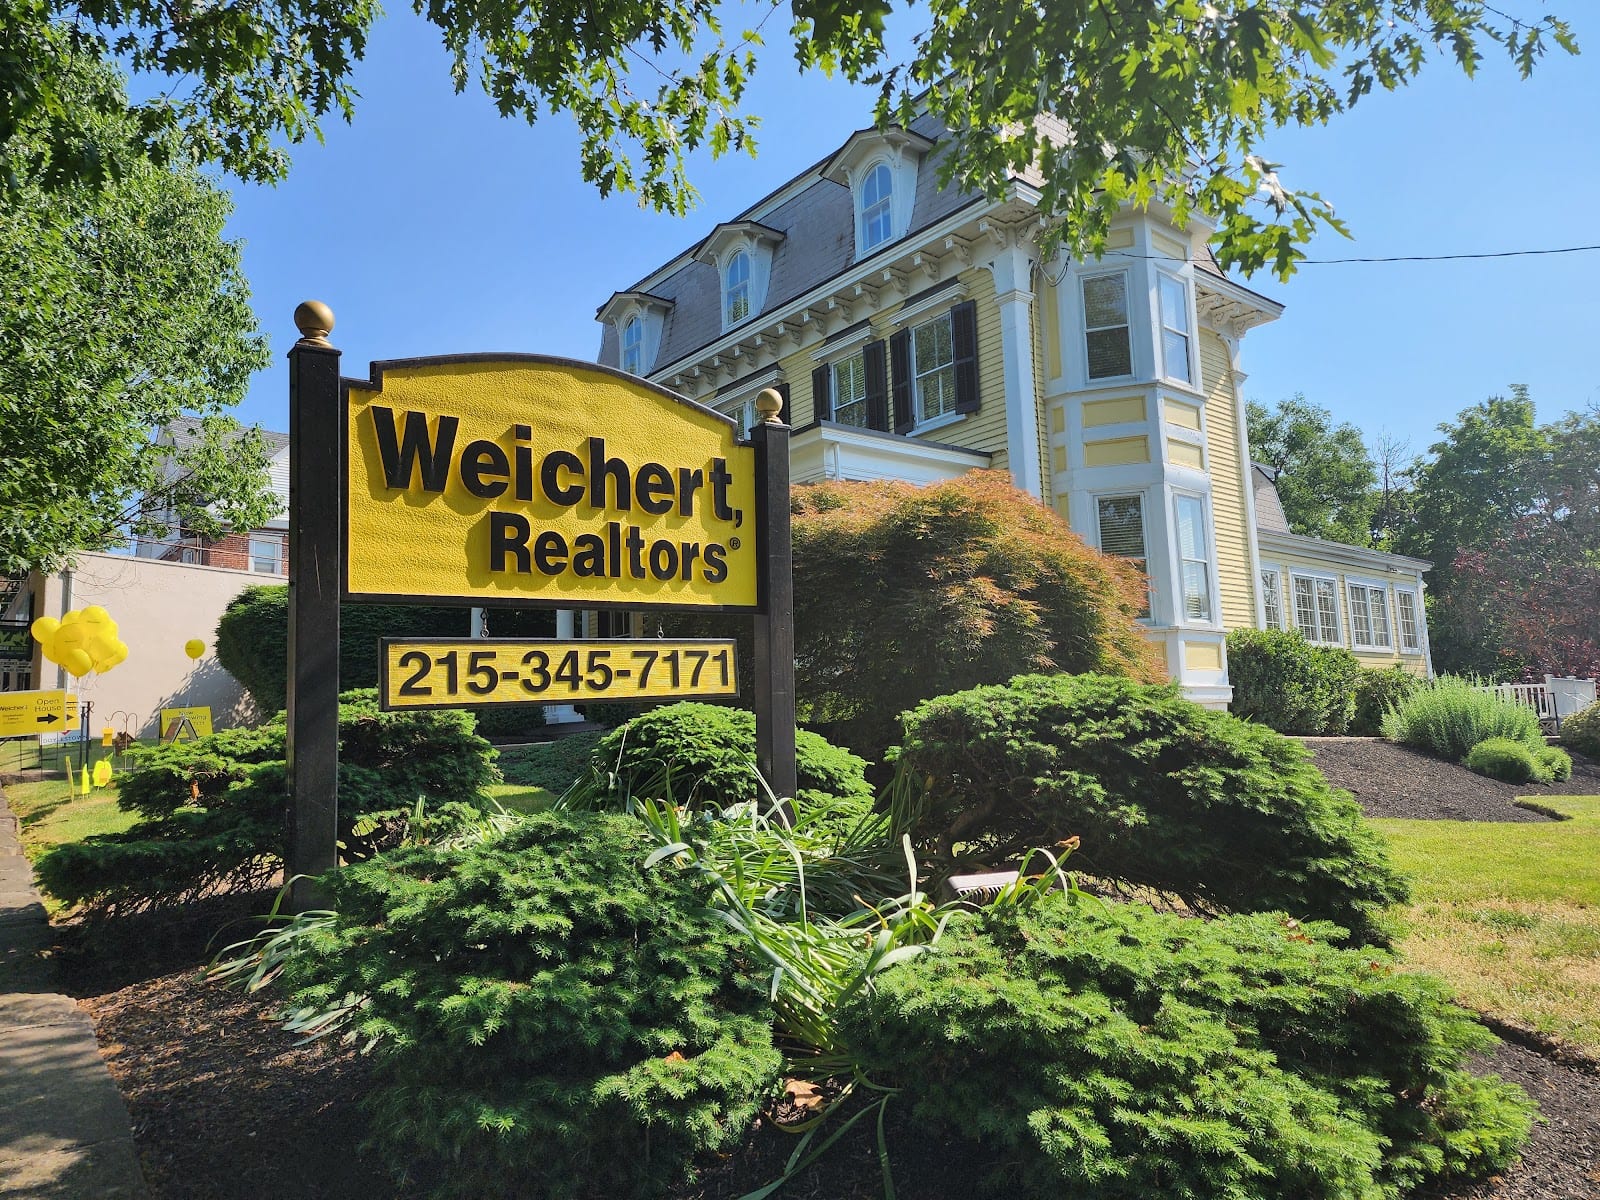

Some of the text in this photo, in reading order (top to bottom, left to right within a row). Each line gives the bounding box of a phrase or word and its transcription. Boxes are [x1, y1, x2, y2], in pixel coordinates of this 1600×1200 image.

[368, 405, 743, 528] Weichert,
[399, 649, 730, 697] 215-345-7171
[34, 705, 62, 713] House
[36, 698, 60, 706] Open
